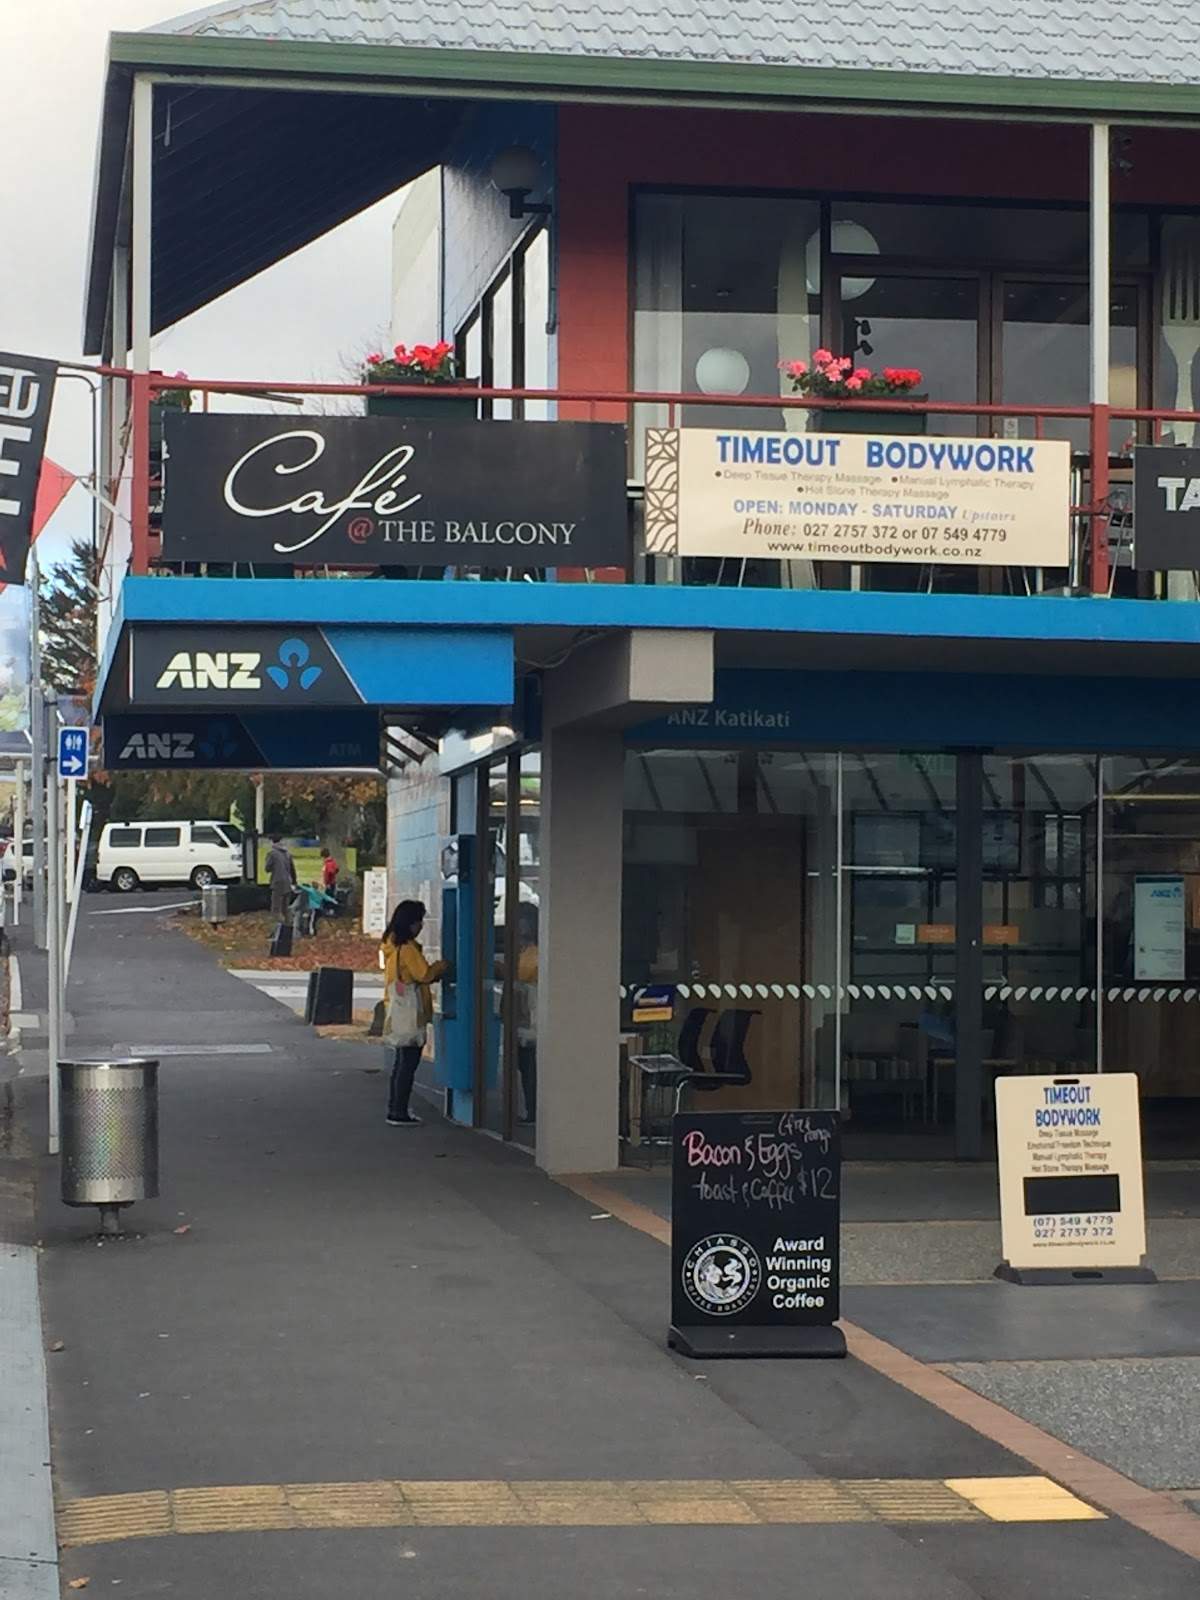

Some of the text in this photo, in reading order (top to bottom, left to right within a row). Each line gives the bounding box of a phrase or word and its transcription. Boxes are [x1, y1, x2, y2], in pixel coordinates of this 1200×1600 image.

[716, 436, 1035, 473] TIMEOUT BODYWORK
[723, 470, 751, 481] Deep
[755, 470, 788, 480] Tissue
[791, 472, 832, 484] Therapy
[835, 473, 882, 485] Massage
[994, 478, 1034, 490] Therapy
[223, 430, 421, 553] Café
[805, 485, 825, 495] Hot
[859, 486, 899, 498] Therapy
[903, 488, 950, 499] Massage
[733, 500, 783, 514] OPEN:
[789, 501, 858, 516] MONDAY
[872, 504, 957, 519] SATURDAY
[348, 516, 577, 545] @ THE BALCONY
[742, 518, 1007, 542] Phone: 027 2757 372 or 07 549 4779
[767, 542, 982, 558] www.timeoutbodywork.co.nz
[156, 652, 261, 689] ANZ
[666, 709, 790, 728] ANZ Katikati
[119, 733, 195, 759] ANZ
[1043, 1086, 1091, 1104] TIMEOUT
[1035, 1108, 1101, 1127] BODYWORK
[682, 1131, 741, 1166] Bacon
[758, 1133, 802, 1180] Eggs
[692, 1171, 738, 1203] toast
[798, 1165, 837, 1200] $12
[1034, 1228, 1055, 1238] 027
[1092, 1227, 1113, 1236] 372
[687, 1237, 757, 1269] CHIASSO
[773, 1237, 825, 1253] Award
[765, 1256, 832, 1273] Winning
[767, 1275, 830, 1293] Organic
[772, 1293, 825, 1309] Coffee
